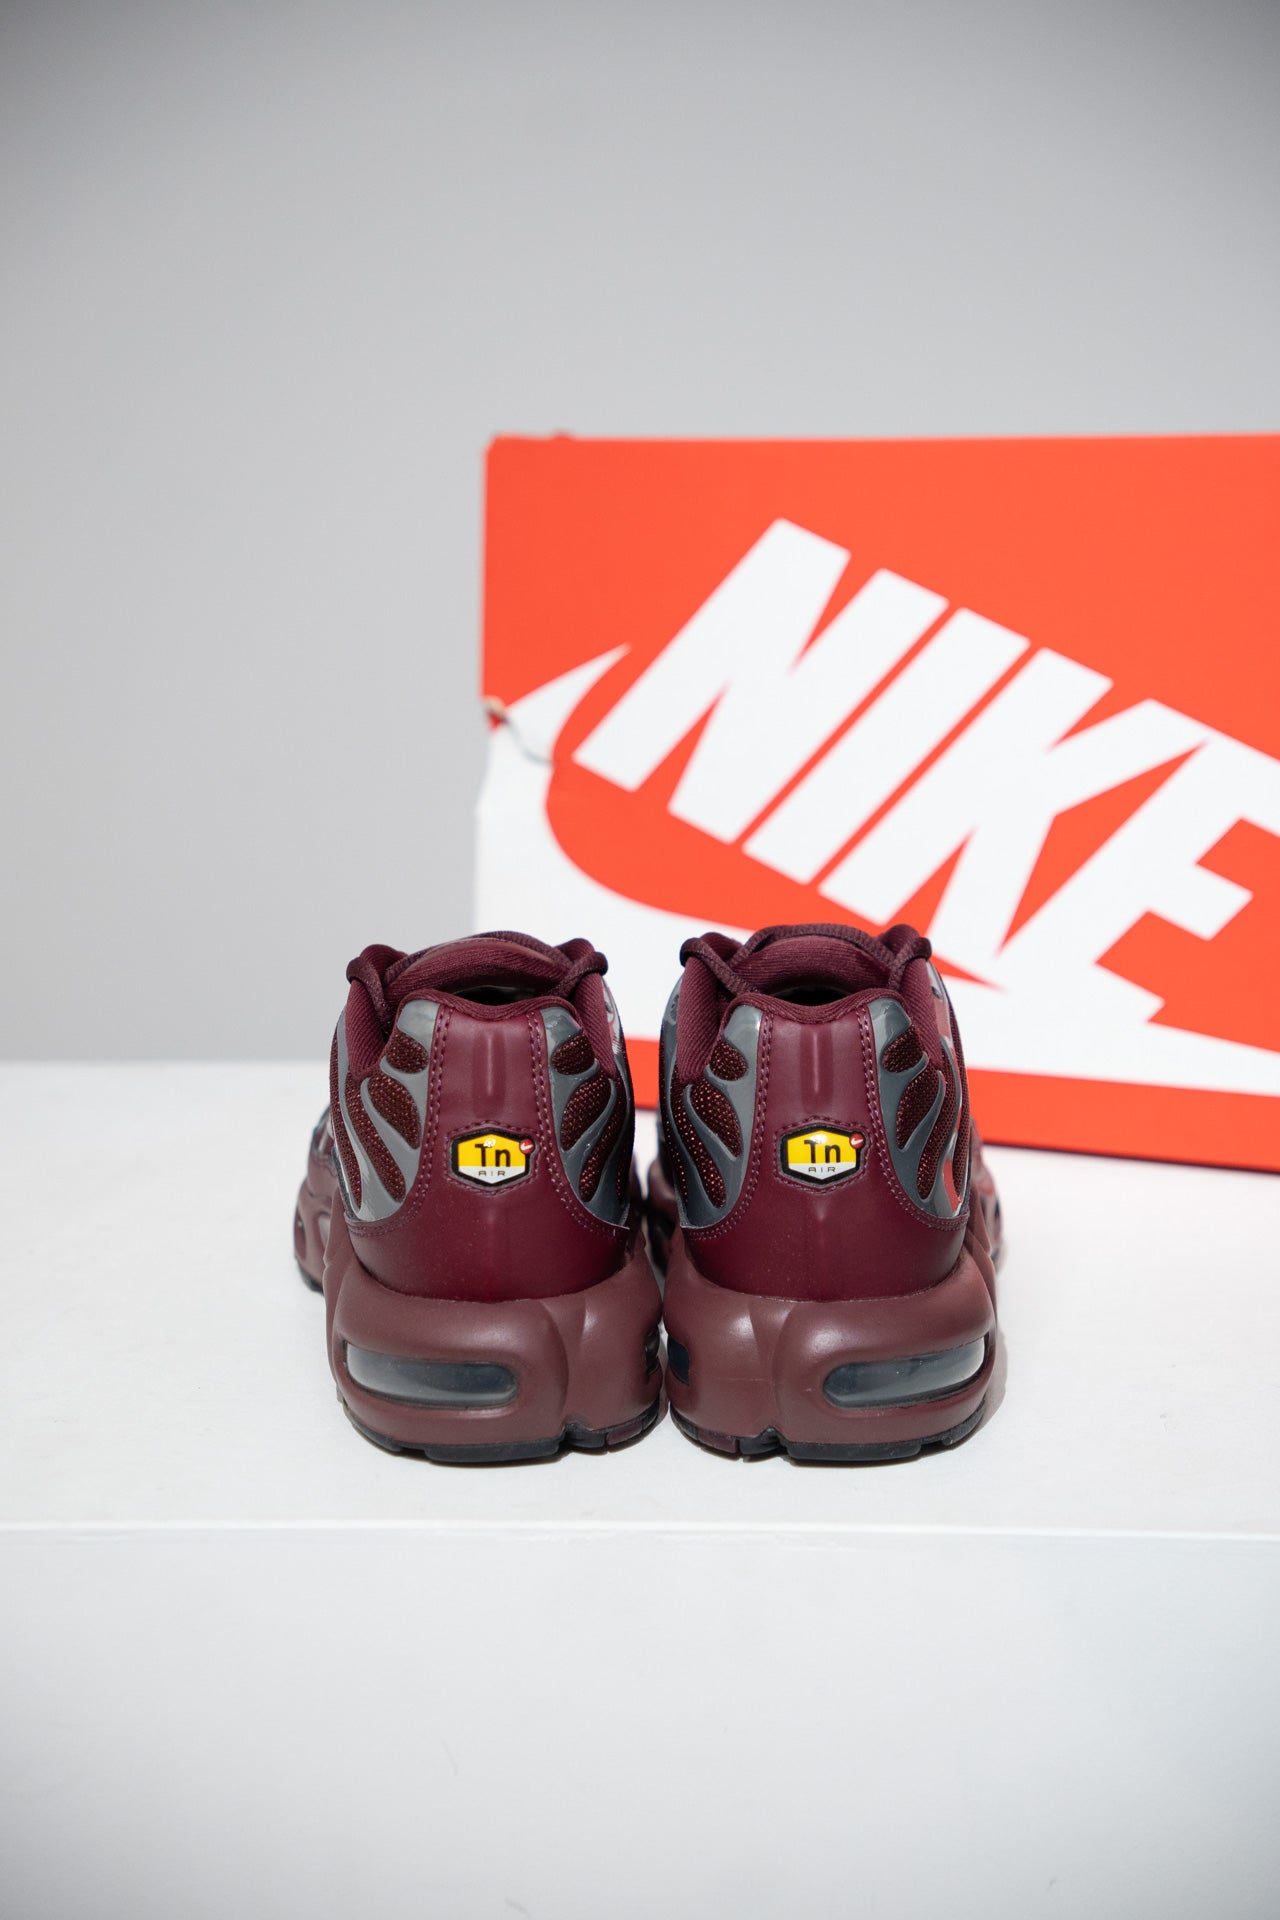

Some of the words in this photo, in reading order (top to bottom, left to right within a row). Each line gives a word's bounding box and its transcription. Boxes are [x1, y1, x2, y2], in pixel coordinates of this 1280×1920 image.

[572, 517, 1280, 1024] NIKE
[474, 1143, 511, 1167] Tn
[804, 1139, 841, 1164] Tn
